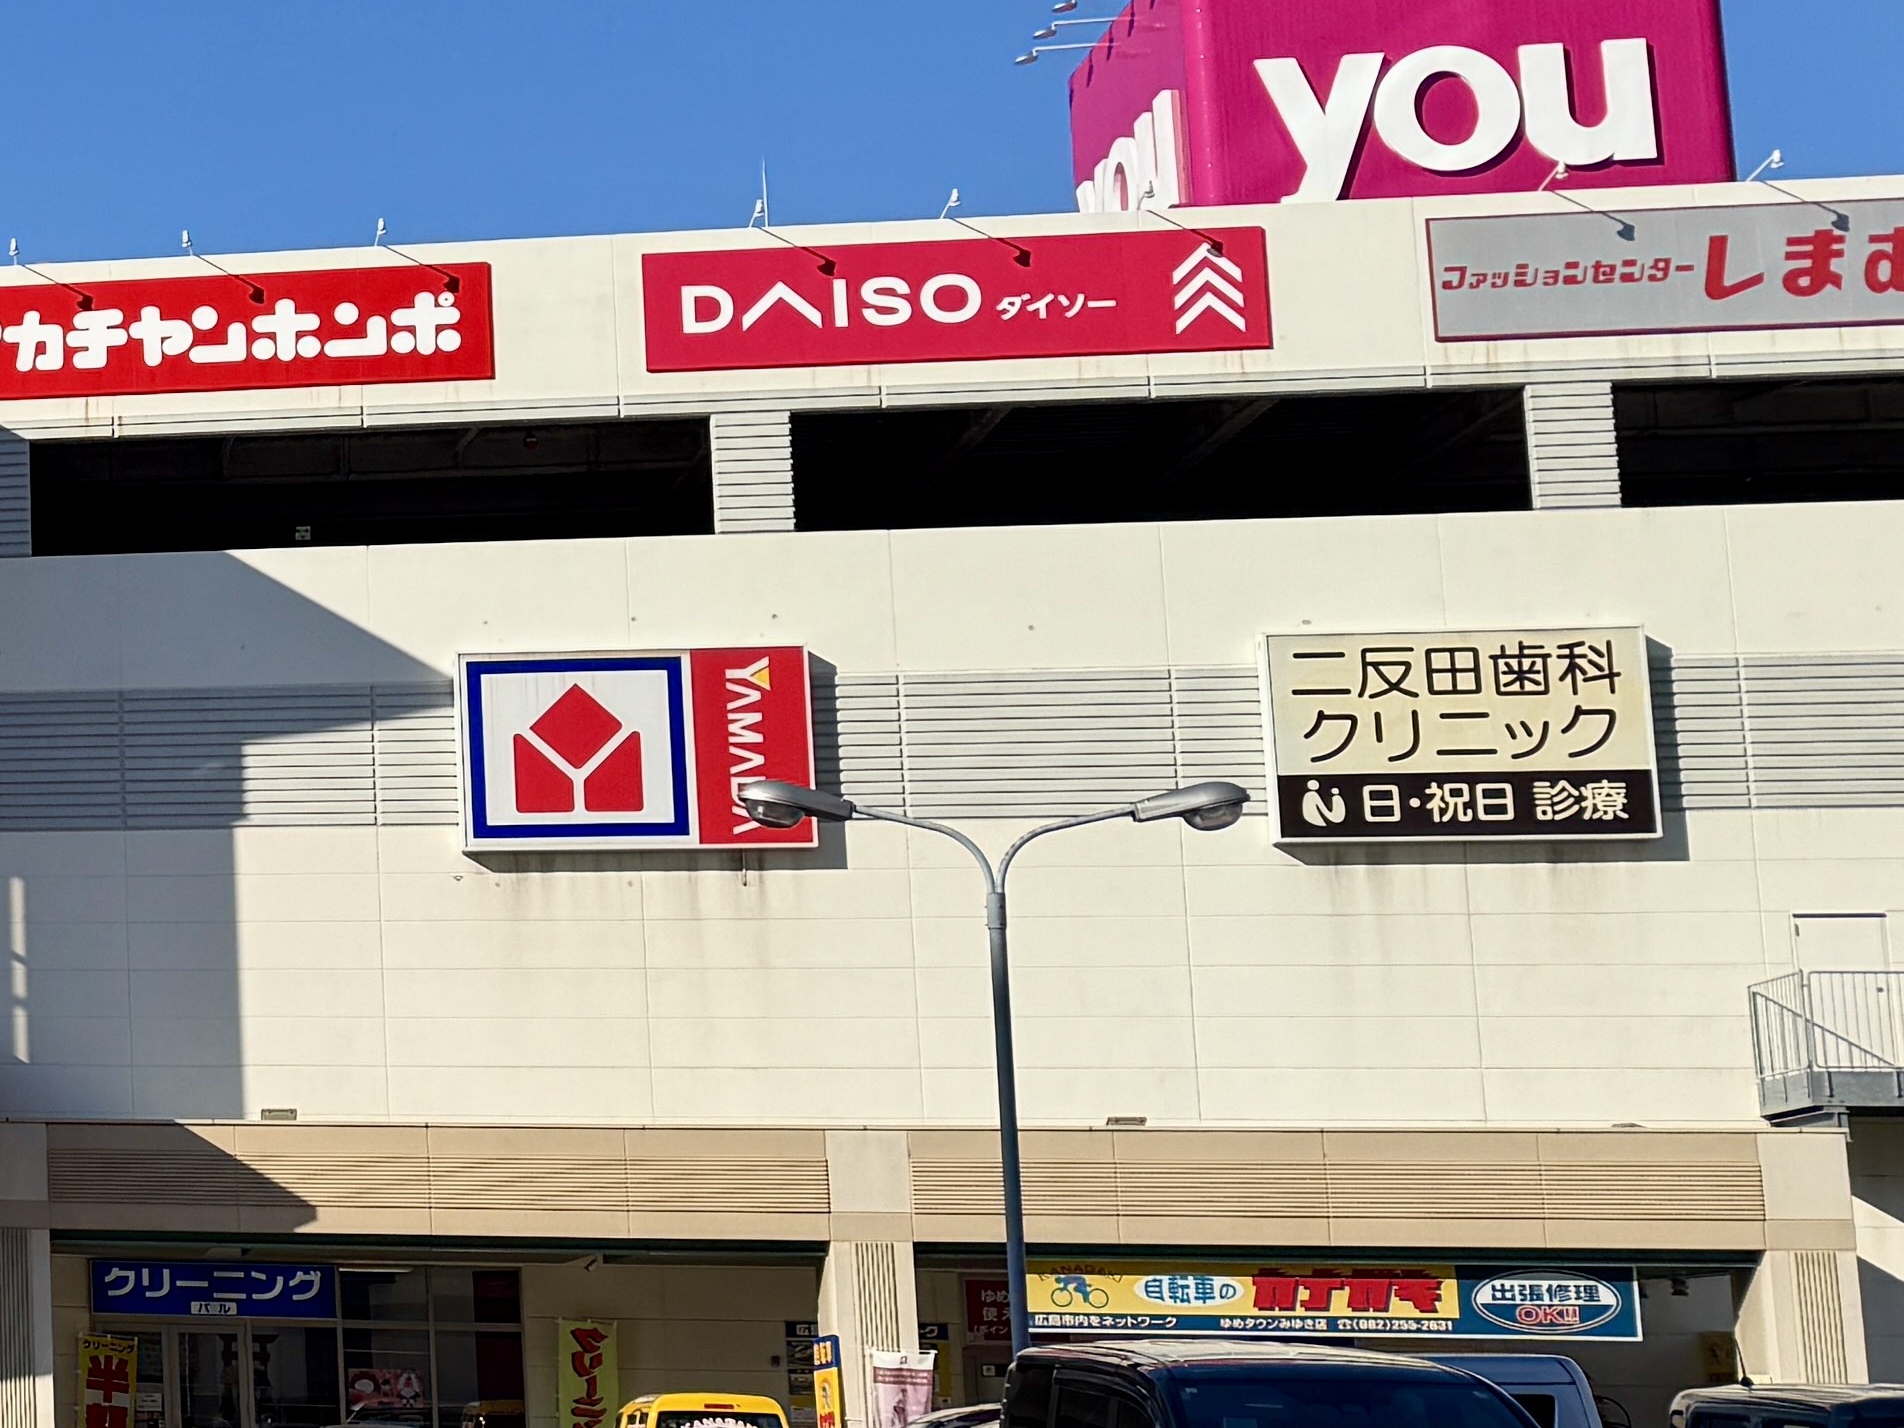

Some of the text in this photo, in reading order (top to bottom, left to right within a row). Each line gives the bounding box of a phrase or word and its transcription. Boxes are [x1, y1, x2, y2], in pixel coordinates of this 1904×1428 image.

[1253, 37, 1658, 204] you
[1441, 257, 1696, 290] ファッションセンター
[680, 272, 1118, 335] DAISO ダイソー
[1291, 639, 1623, 699] 二反田歯科
[1302, 704, 1618, 763] クリニック
[1532, 778, 1631, 823] 診療
[104, 1266, 322, 1301] クリーニング
[1144, 1275, 1237, 1305] 自転車の
[1491, 1283, 1602, 1303] 出張修理
[1220, 1317, 1328, 1331] ゆめタウンみゆき店
[1515, 1304, 1581, 1325] OK!!
[82, 1338, 135, 1355] クリーニング
